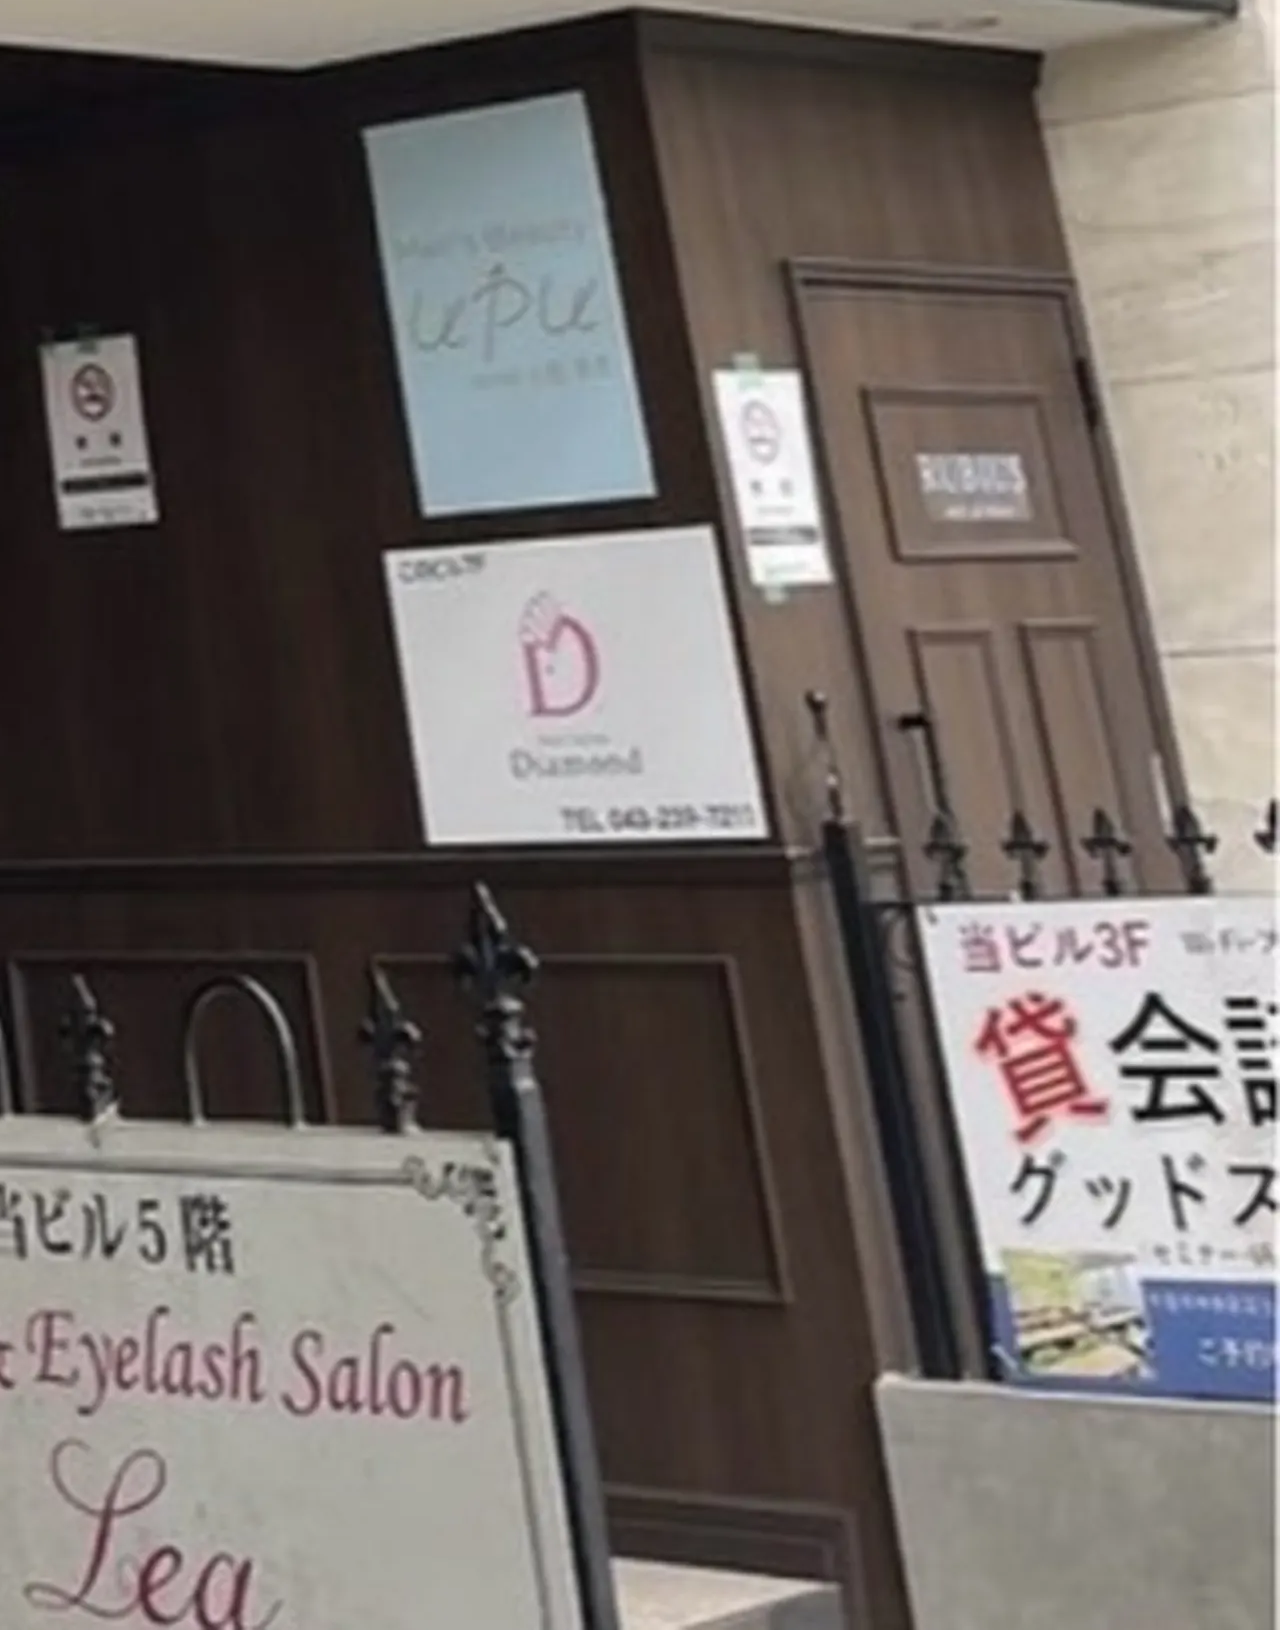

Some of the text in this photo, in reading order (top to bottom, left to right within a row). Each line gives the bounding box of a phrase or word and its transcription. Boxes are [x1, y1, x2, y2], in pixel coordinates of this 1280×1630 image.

[508, 745, 645, 781] Diamond
[558, 805, 605, 834] TEL
[958, 919, 1150, 974] 当ビル3F
[26, 1305, 264, 1417] Eyelash
[281, 1322, 470, 1424] Salon
[23, 1437, 283, 1630] Lea
